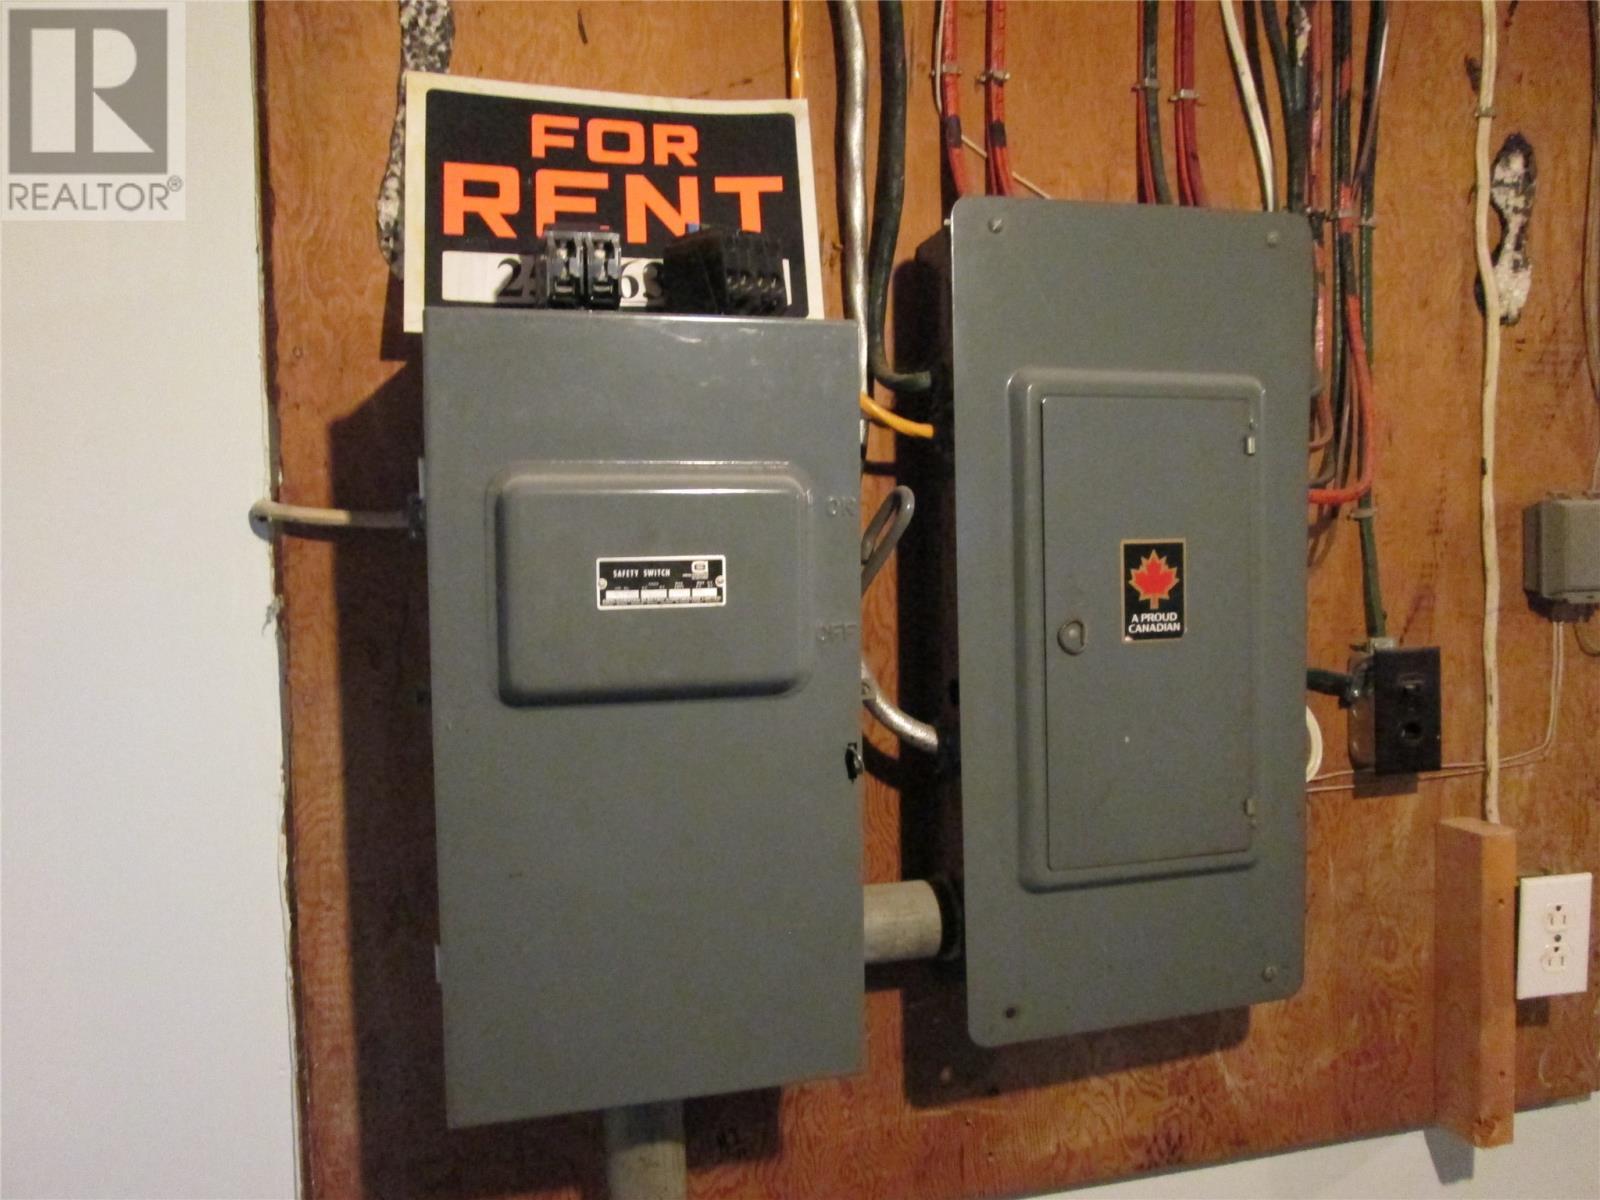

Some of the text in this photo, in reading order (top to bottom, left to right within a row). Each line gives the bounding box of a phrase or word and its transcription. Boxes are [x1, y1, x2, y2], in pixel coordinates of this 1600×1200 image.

[530, 113, 699, 167] FOR
[442, 160, 784, 245] RENT
[612, 568, 639, 578] SAFETY
[643, 568, 671, 578] SWITCH
[1131, 612, 1178, 622] A PROUD
[1128, 622, 1181, 633] CANADIAN
